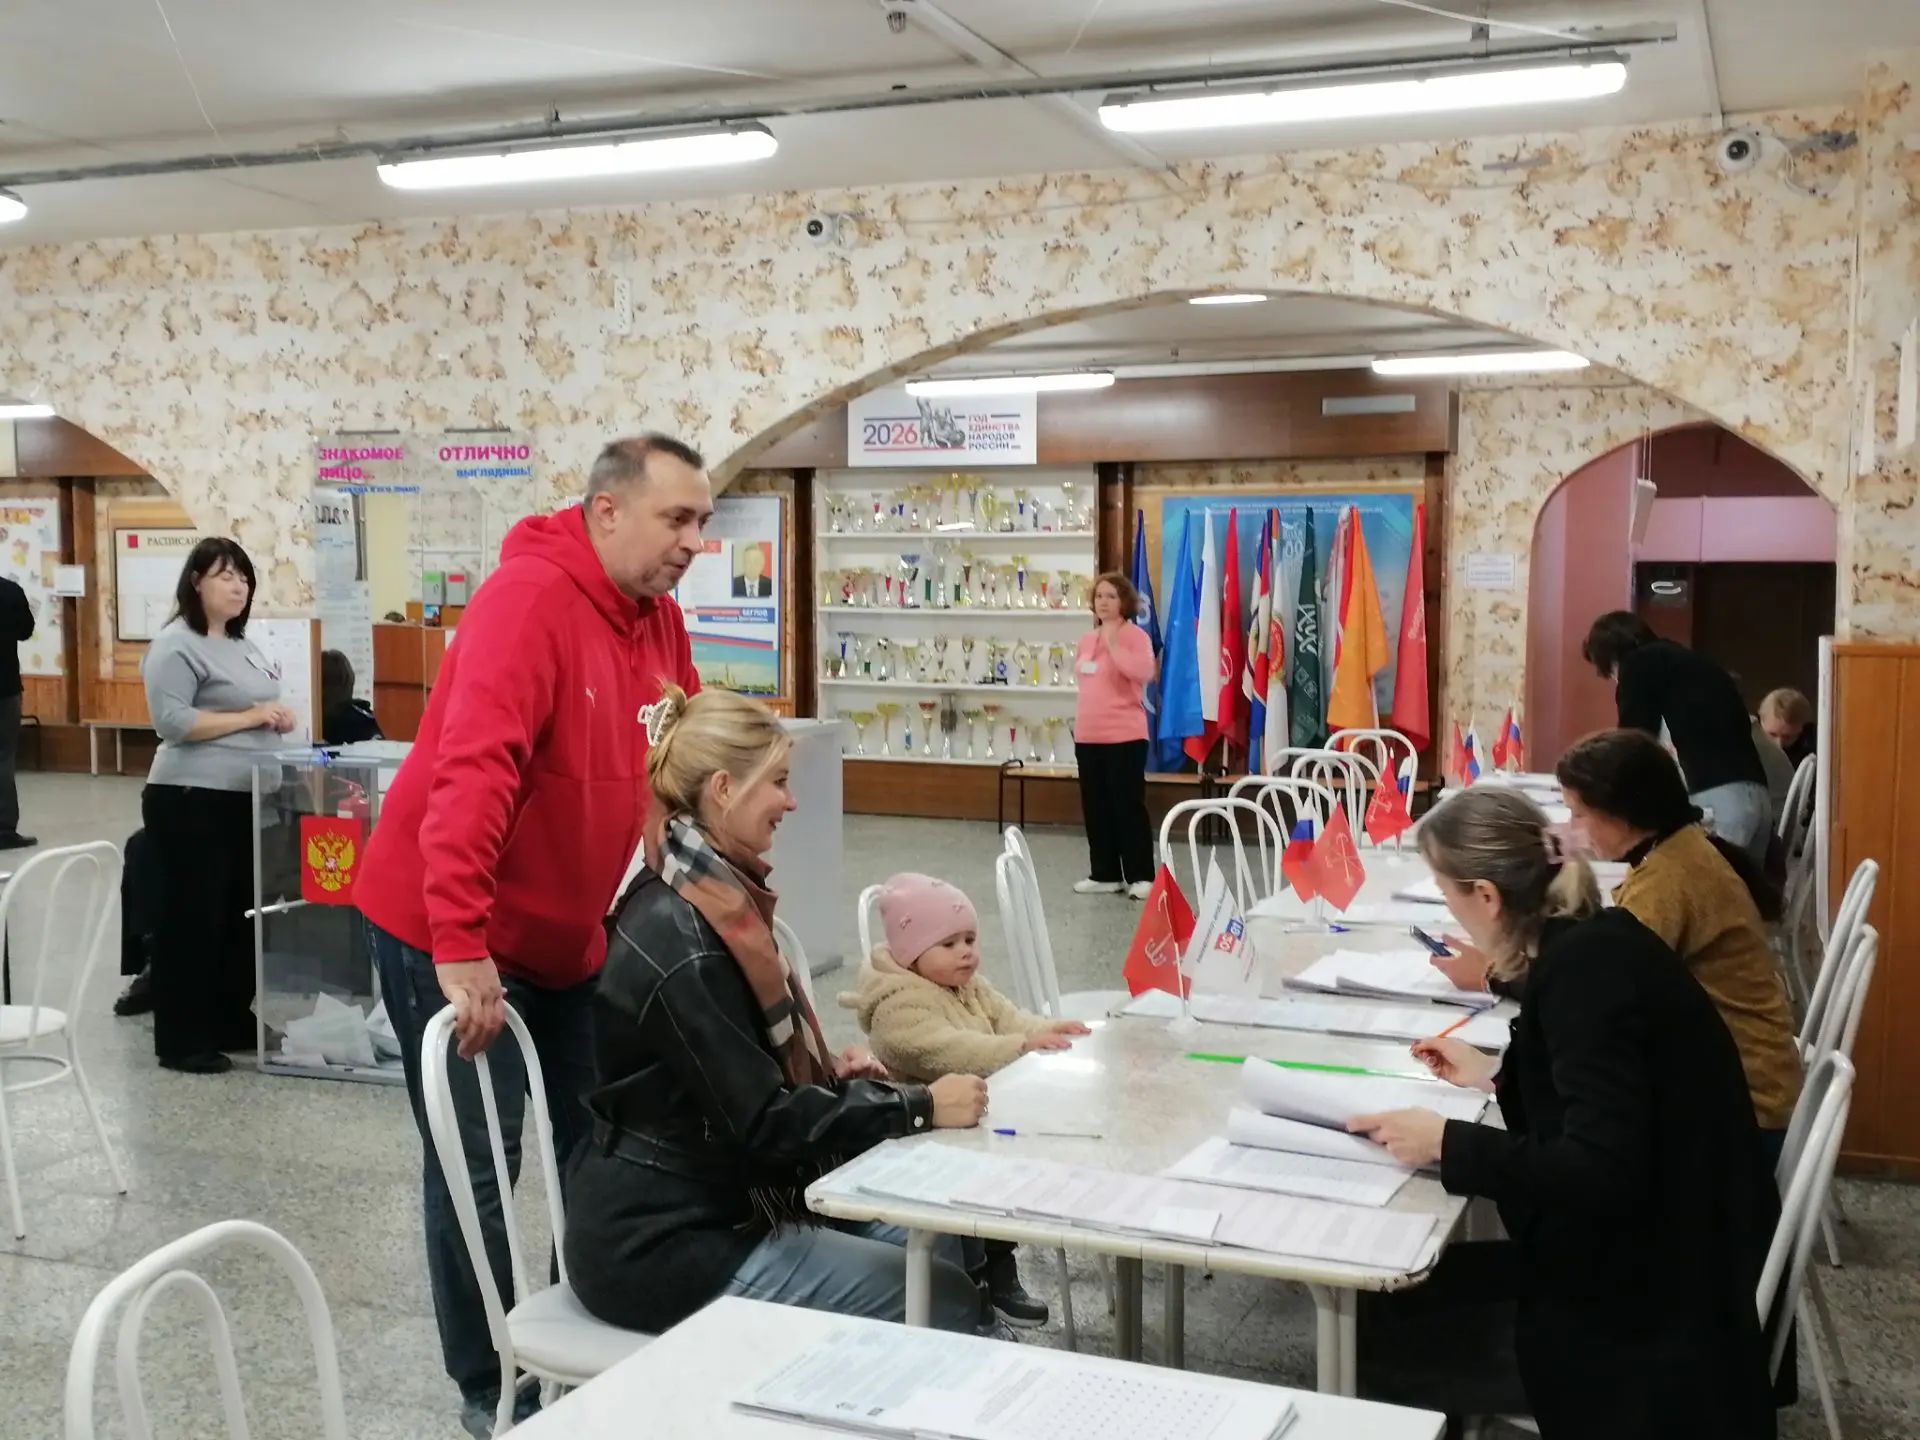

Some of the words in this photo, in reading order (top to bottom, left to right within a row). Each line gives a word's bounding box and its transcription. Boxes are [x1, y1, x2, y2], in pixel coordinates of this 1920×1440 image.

[968, 414, 988, 423] ГОД
[968, 423, 1020, 432] ЕДИНСТВА
[863, 424, 918, 445] 2026
[968, 433, 1015, 441] НАРОДОВ
[968, 442, 1010, 451] РОССИИ
[318, 446, 404, 461] ЗНАКОМОЕ
[438, 445, 530, 461] ОТЛИЧНО
[147, 537, 201, 546] РАСПИСАН
